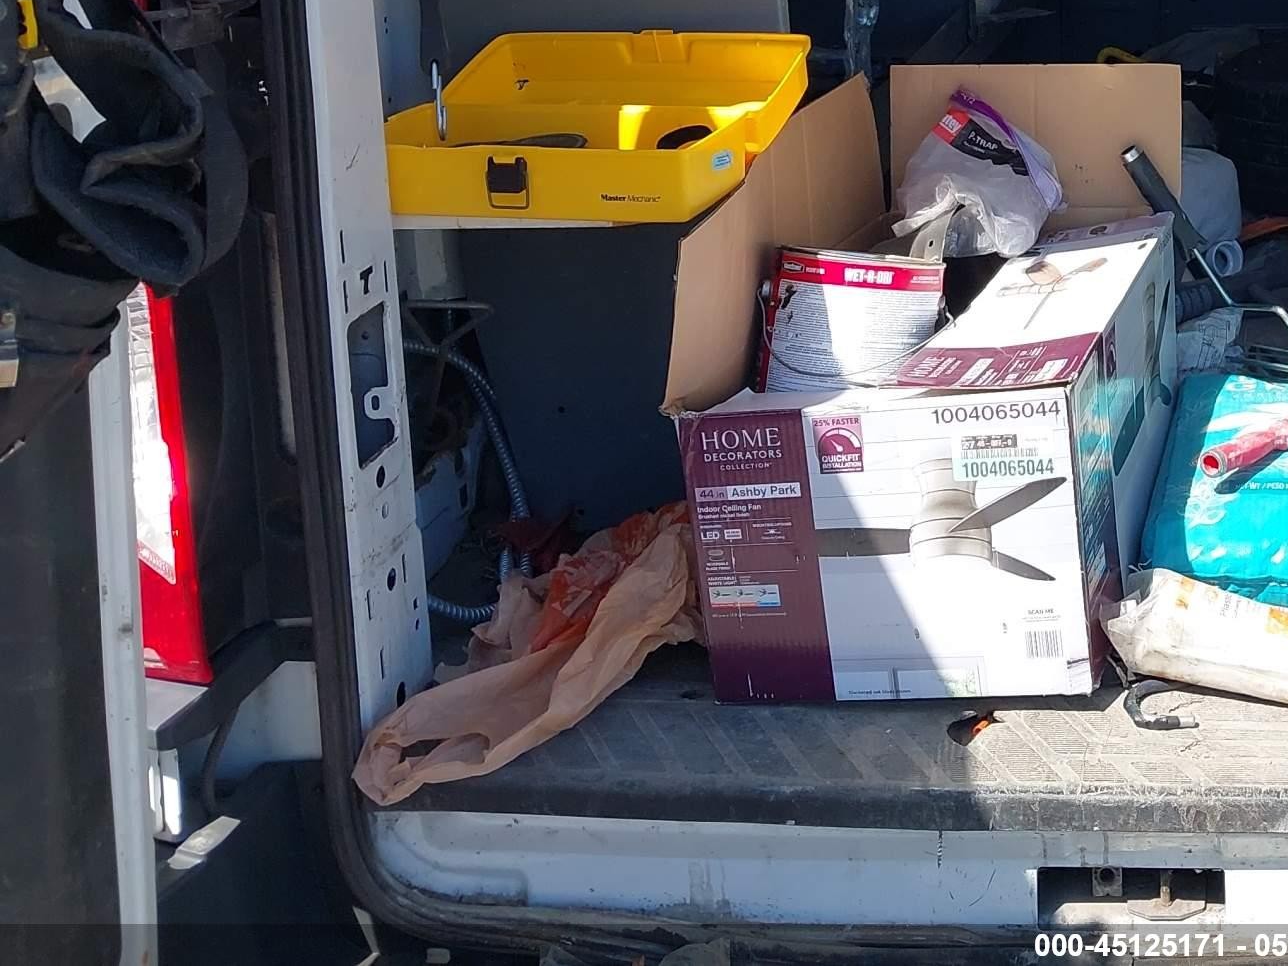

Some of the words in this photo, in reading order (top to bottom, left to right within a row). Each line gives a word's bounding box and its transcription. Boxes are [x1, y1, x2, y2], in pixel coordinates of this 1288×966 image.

[600, 193, 626, 202] Master
[931, 400, 1061, 424] 1004065044
[831, 417, 860, 427] FASTER
[701, 427, 781, 451] HOME
[704, 449, 782, 463] DECORATORS
[821, 453, 861, 463] QUICKFIT
[962, 458, 1055, 479] 1004065044
[700, 489, 714, 499] 44
[716, 490, 725, 498] in
[731, 487, 767, 499] Ashby
[770, 484, 797, 496] Park
[721, 504, 747, 513] Ceiling
[748, 503, 762, 511] Fan
[700, 531, 720, 541] LED
